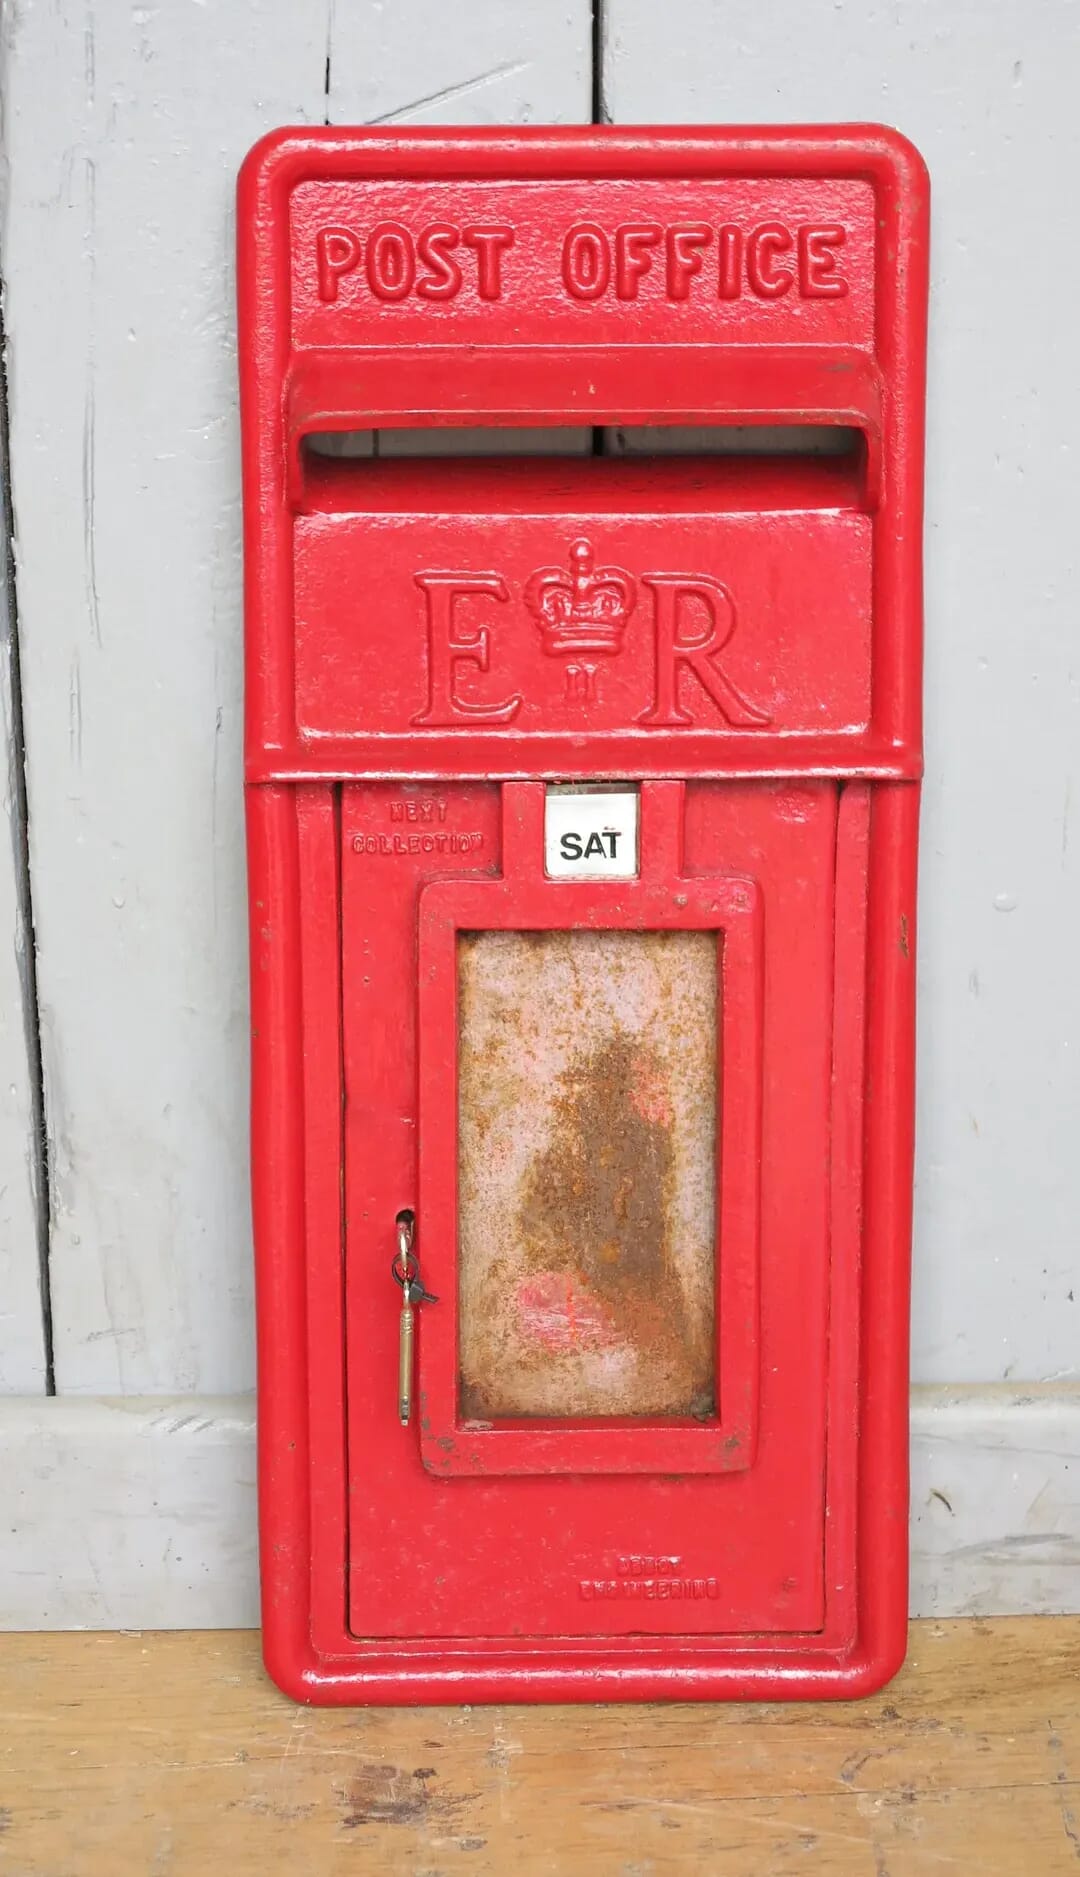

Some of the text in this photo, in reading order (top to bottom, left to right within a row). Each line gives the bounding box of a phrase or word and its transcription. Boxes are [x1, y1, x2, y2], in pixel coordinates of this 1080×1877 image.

[316, 220, 850, 301] POST OFFICE
[409, 569, 773, 727] E R
[389, 801, 447, 822] NEXT
[352, 832, 484, 855] COLLECTION
[560, 832, 622, 861] SAT
